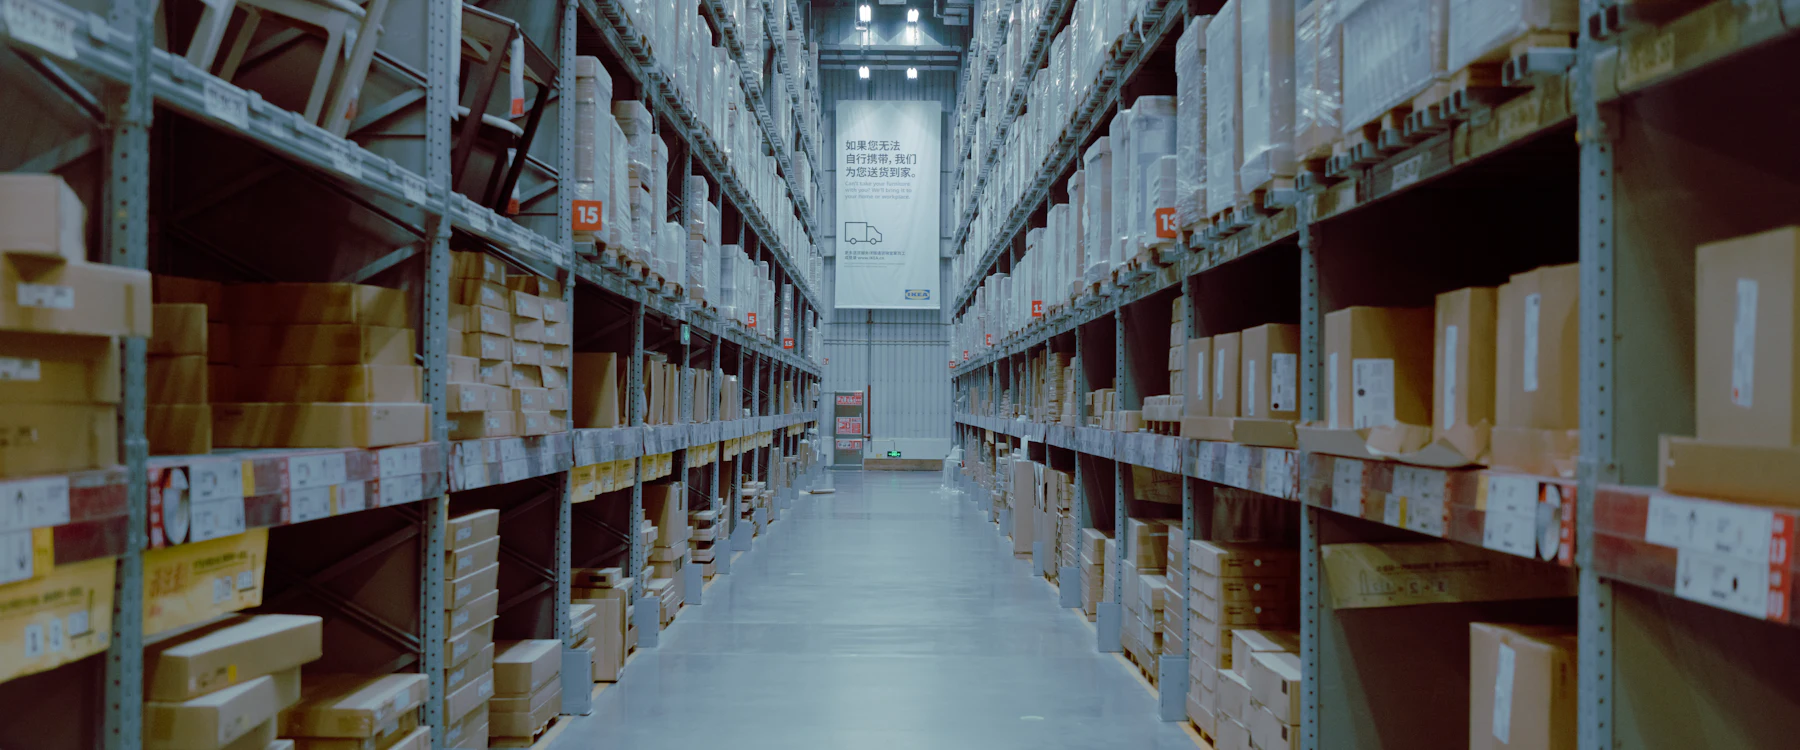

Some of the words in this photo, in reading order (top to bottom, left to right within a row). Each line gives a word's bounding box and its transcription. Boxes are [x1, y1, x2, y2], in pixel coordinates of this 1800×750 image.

[845, 140, 901, 151] 如果您无法
[845, 166, 916, 178] 为您送货到家。
[578, 206, 598, 225] 15
[1160, 214, 1177, 231] 13
